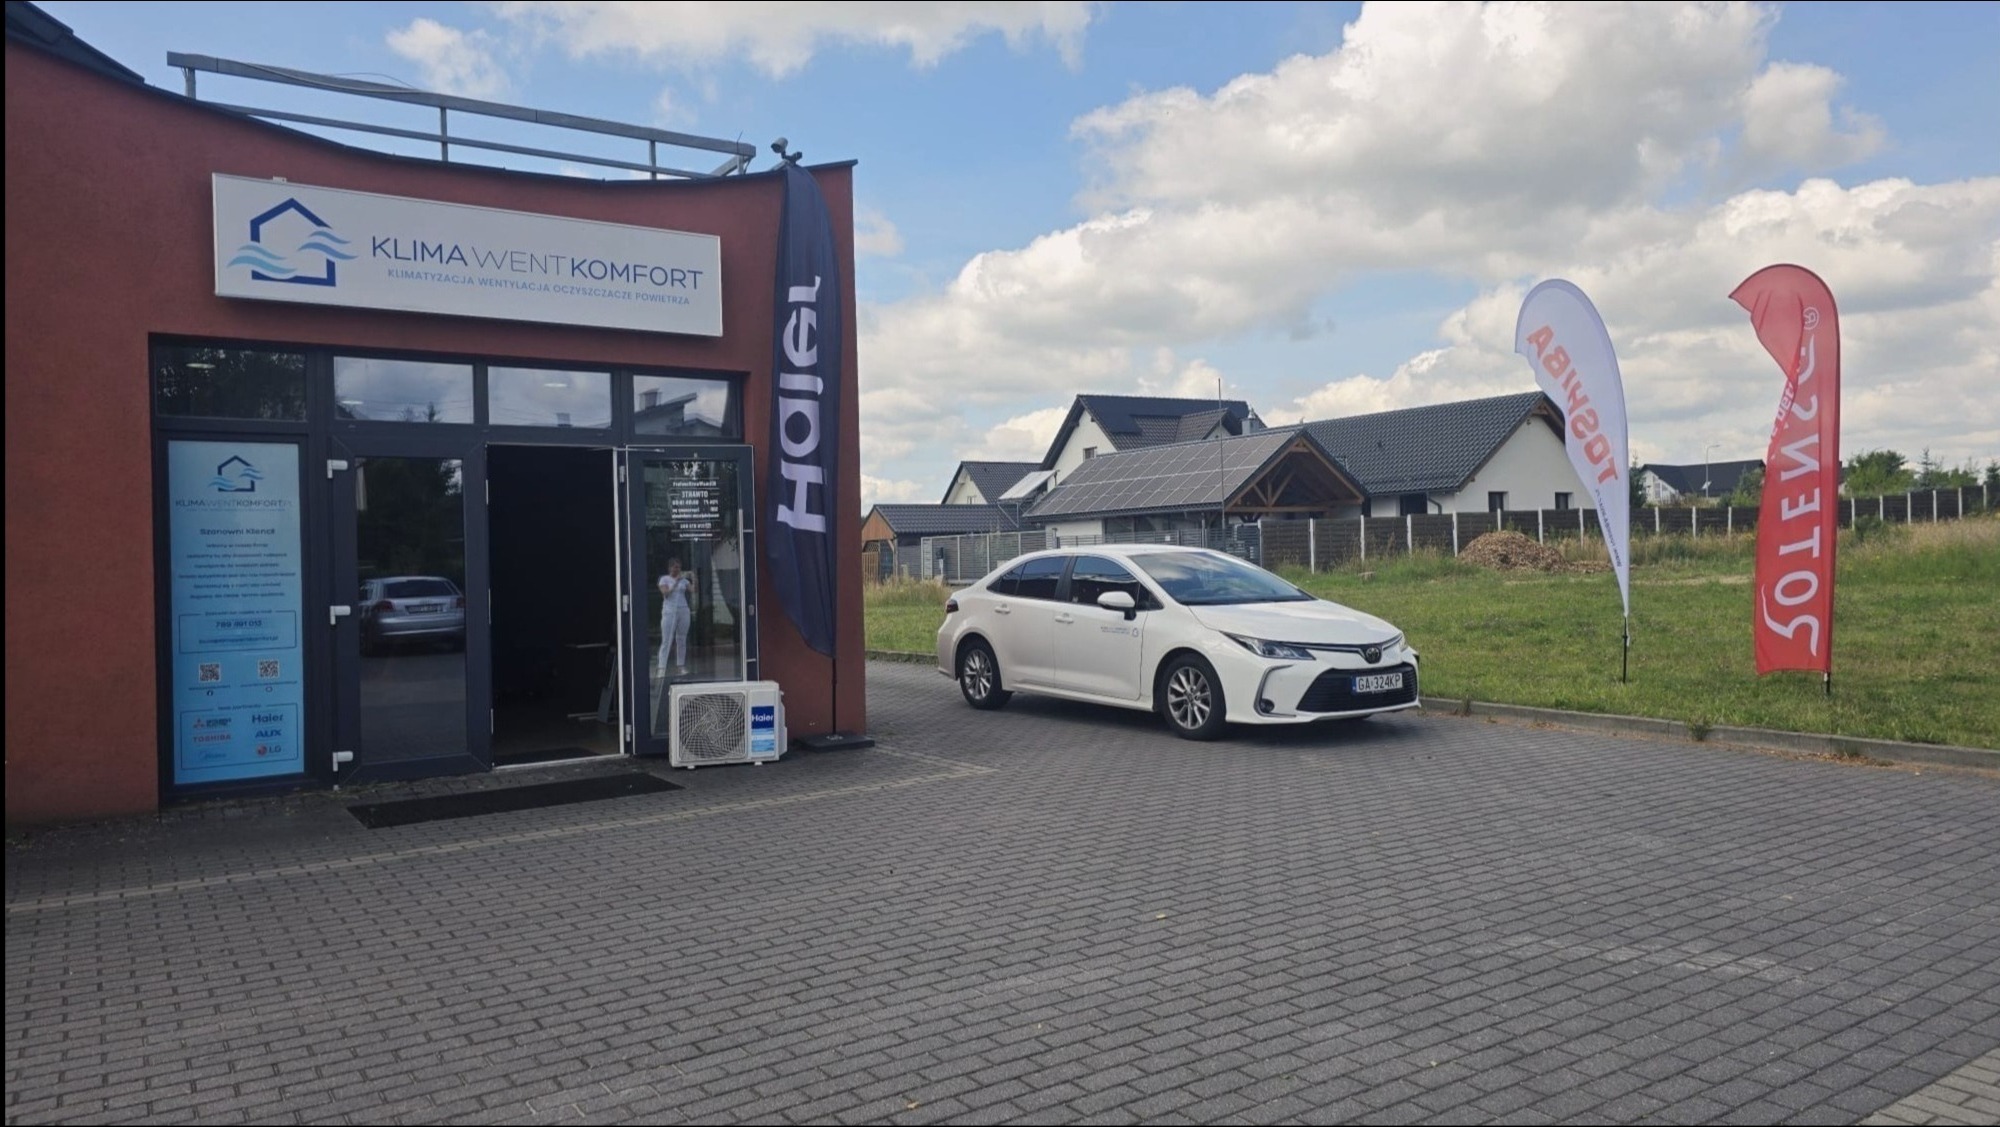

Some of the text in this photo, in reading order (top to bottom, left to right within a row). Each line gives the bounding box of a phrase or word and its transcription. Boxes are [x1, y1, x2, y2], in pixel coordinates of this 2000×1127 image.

[387, 269, 690, 304] KLIMATYZACJA WENTYLACJA OCZYSZCZACZE POWIETRZA
[1358, 674, 1401, 691] GA 324KP
[251, 713, 284, 723] Haier
[751, 714, 774, 722] Haier
[193, 734, 232, 743] TOSHIBA
[255, 729, 282, 739] AUX
[268, 744, 282, 754] LG
